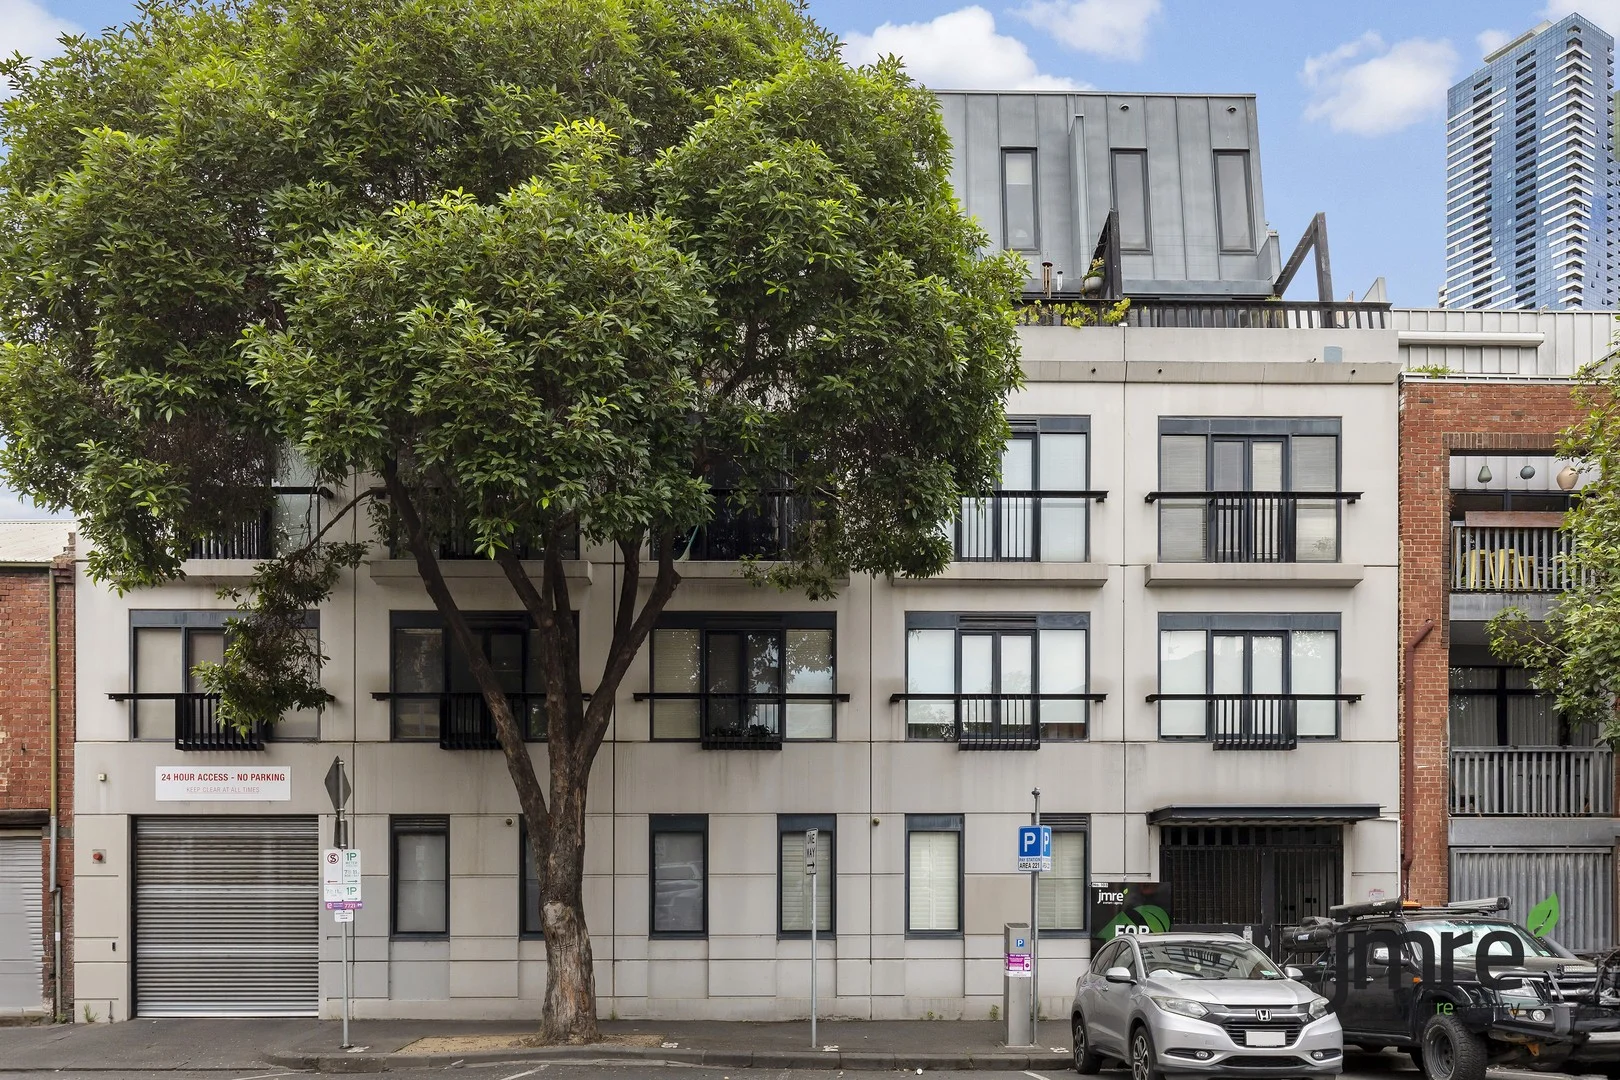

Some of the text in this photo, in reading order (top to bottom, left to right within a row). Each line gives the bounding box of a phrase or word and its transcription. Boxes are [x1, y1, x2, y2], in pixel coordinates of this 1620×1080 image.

[161, 773, 171, 781] 24
[173, 773, 195, 781] HOUR
[197, 773, 229, 782] ACCESS
[237, 773, 248, 781] NO
[251, 773, 285, 781] PARKING
[1024, 832, 1036, 852] P
[1044, 832, 1050, 852] P
[346, 852, 357, 861] 1P
[346, 887, 357, 896] 1P
[1097, 889, 1124, 904] jmre
[1017, 939, 1024, 947] P
